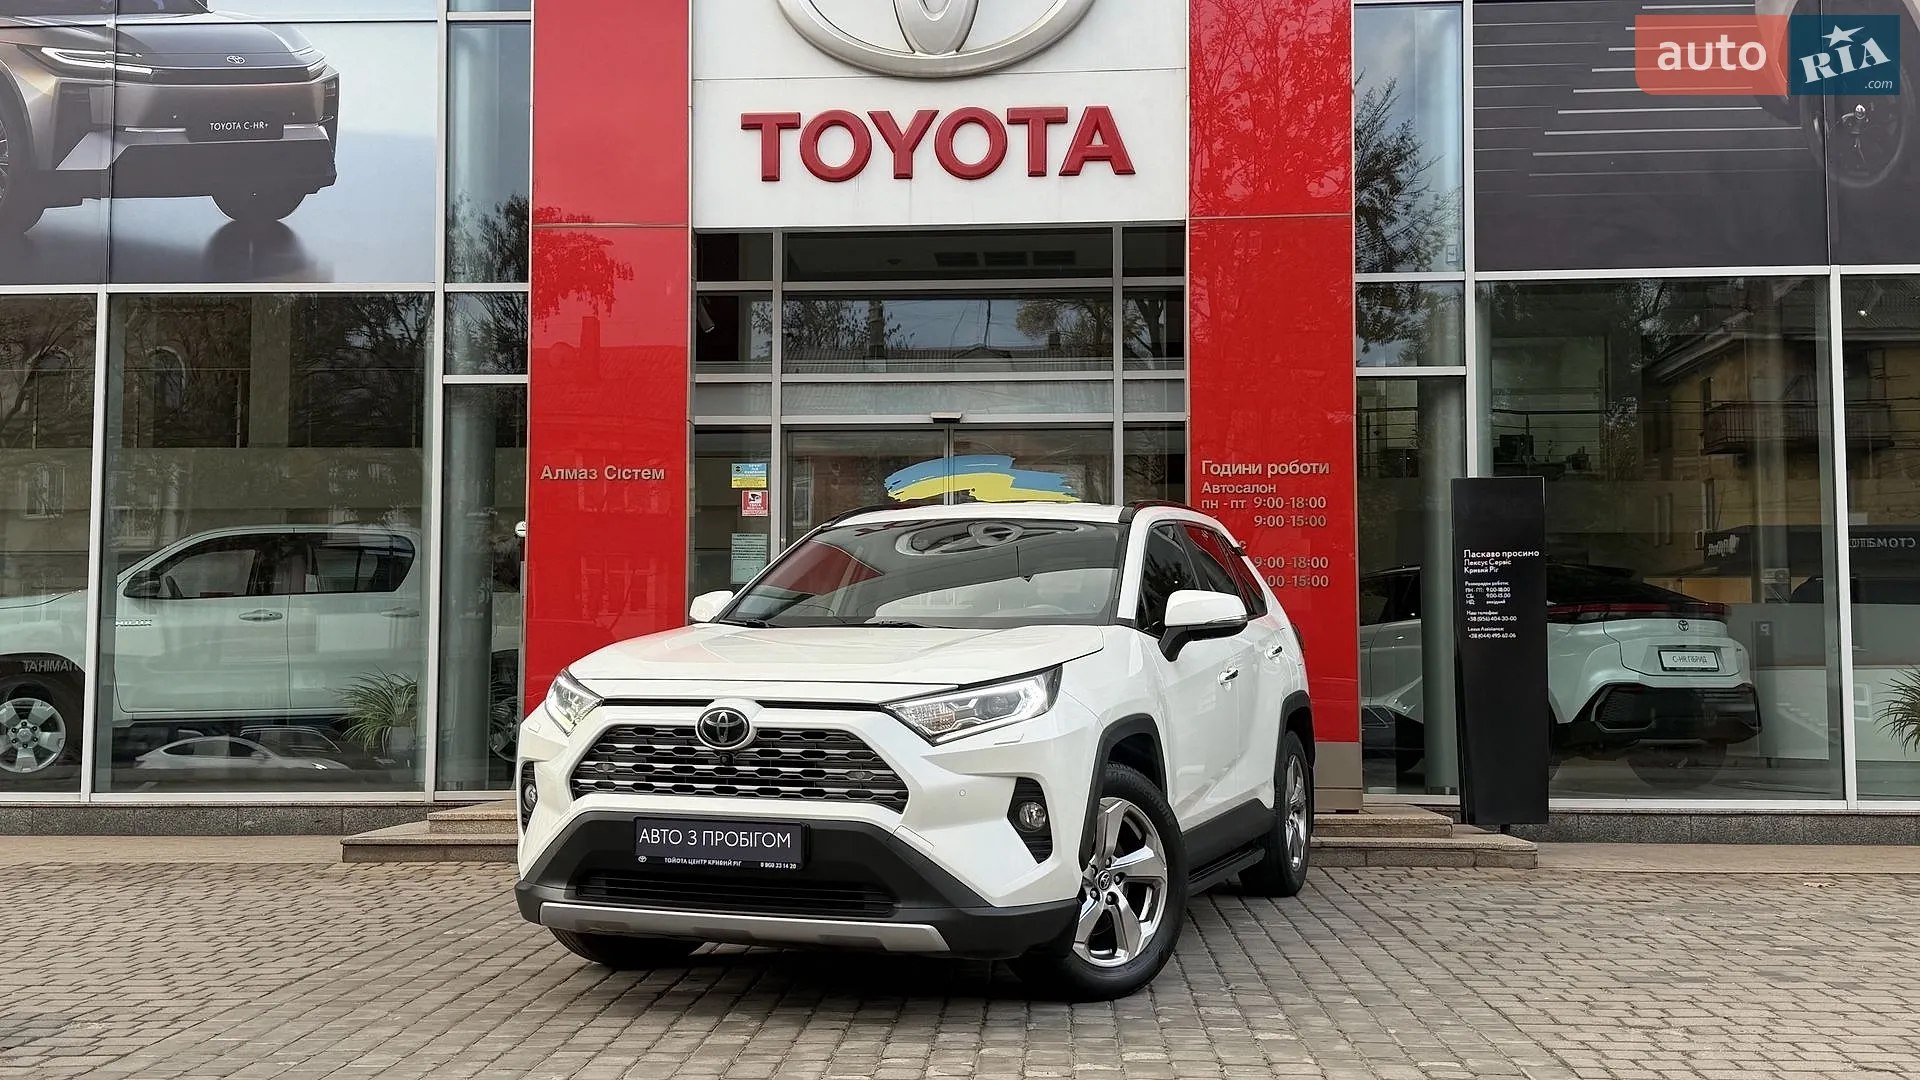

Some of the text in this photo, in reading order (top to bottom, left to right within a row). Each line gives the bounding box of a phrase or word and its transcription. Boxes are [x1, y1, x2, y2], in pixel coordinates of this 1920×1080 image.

[209, 121, 269, 131] TOYOTA C-HR+
[740, 105, 1137, 183] TOYOTA
[540, 465, 665, 480] Алмаз Сістем
[1201, 459, 1330, 478] Години роботи
[1201, 482, 1277, 494] Автосалон
[1201, 499, 1219, 509] пн
[1230, 499, 1247, 509] пт
[1253, 515, 1327, 527] 9:00-15:00
[1254, 556, 1329, 569] 9:00-18:00
[1267, 575, 1329, 588] 00-15:00
[638, 827, 683, 845] АВТО
[702, 829, 791, 849] ПРОБІГОМ
